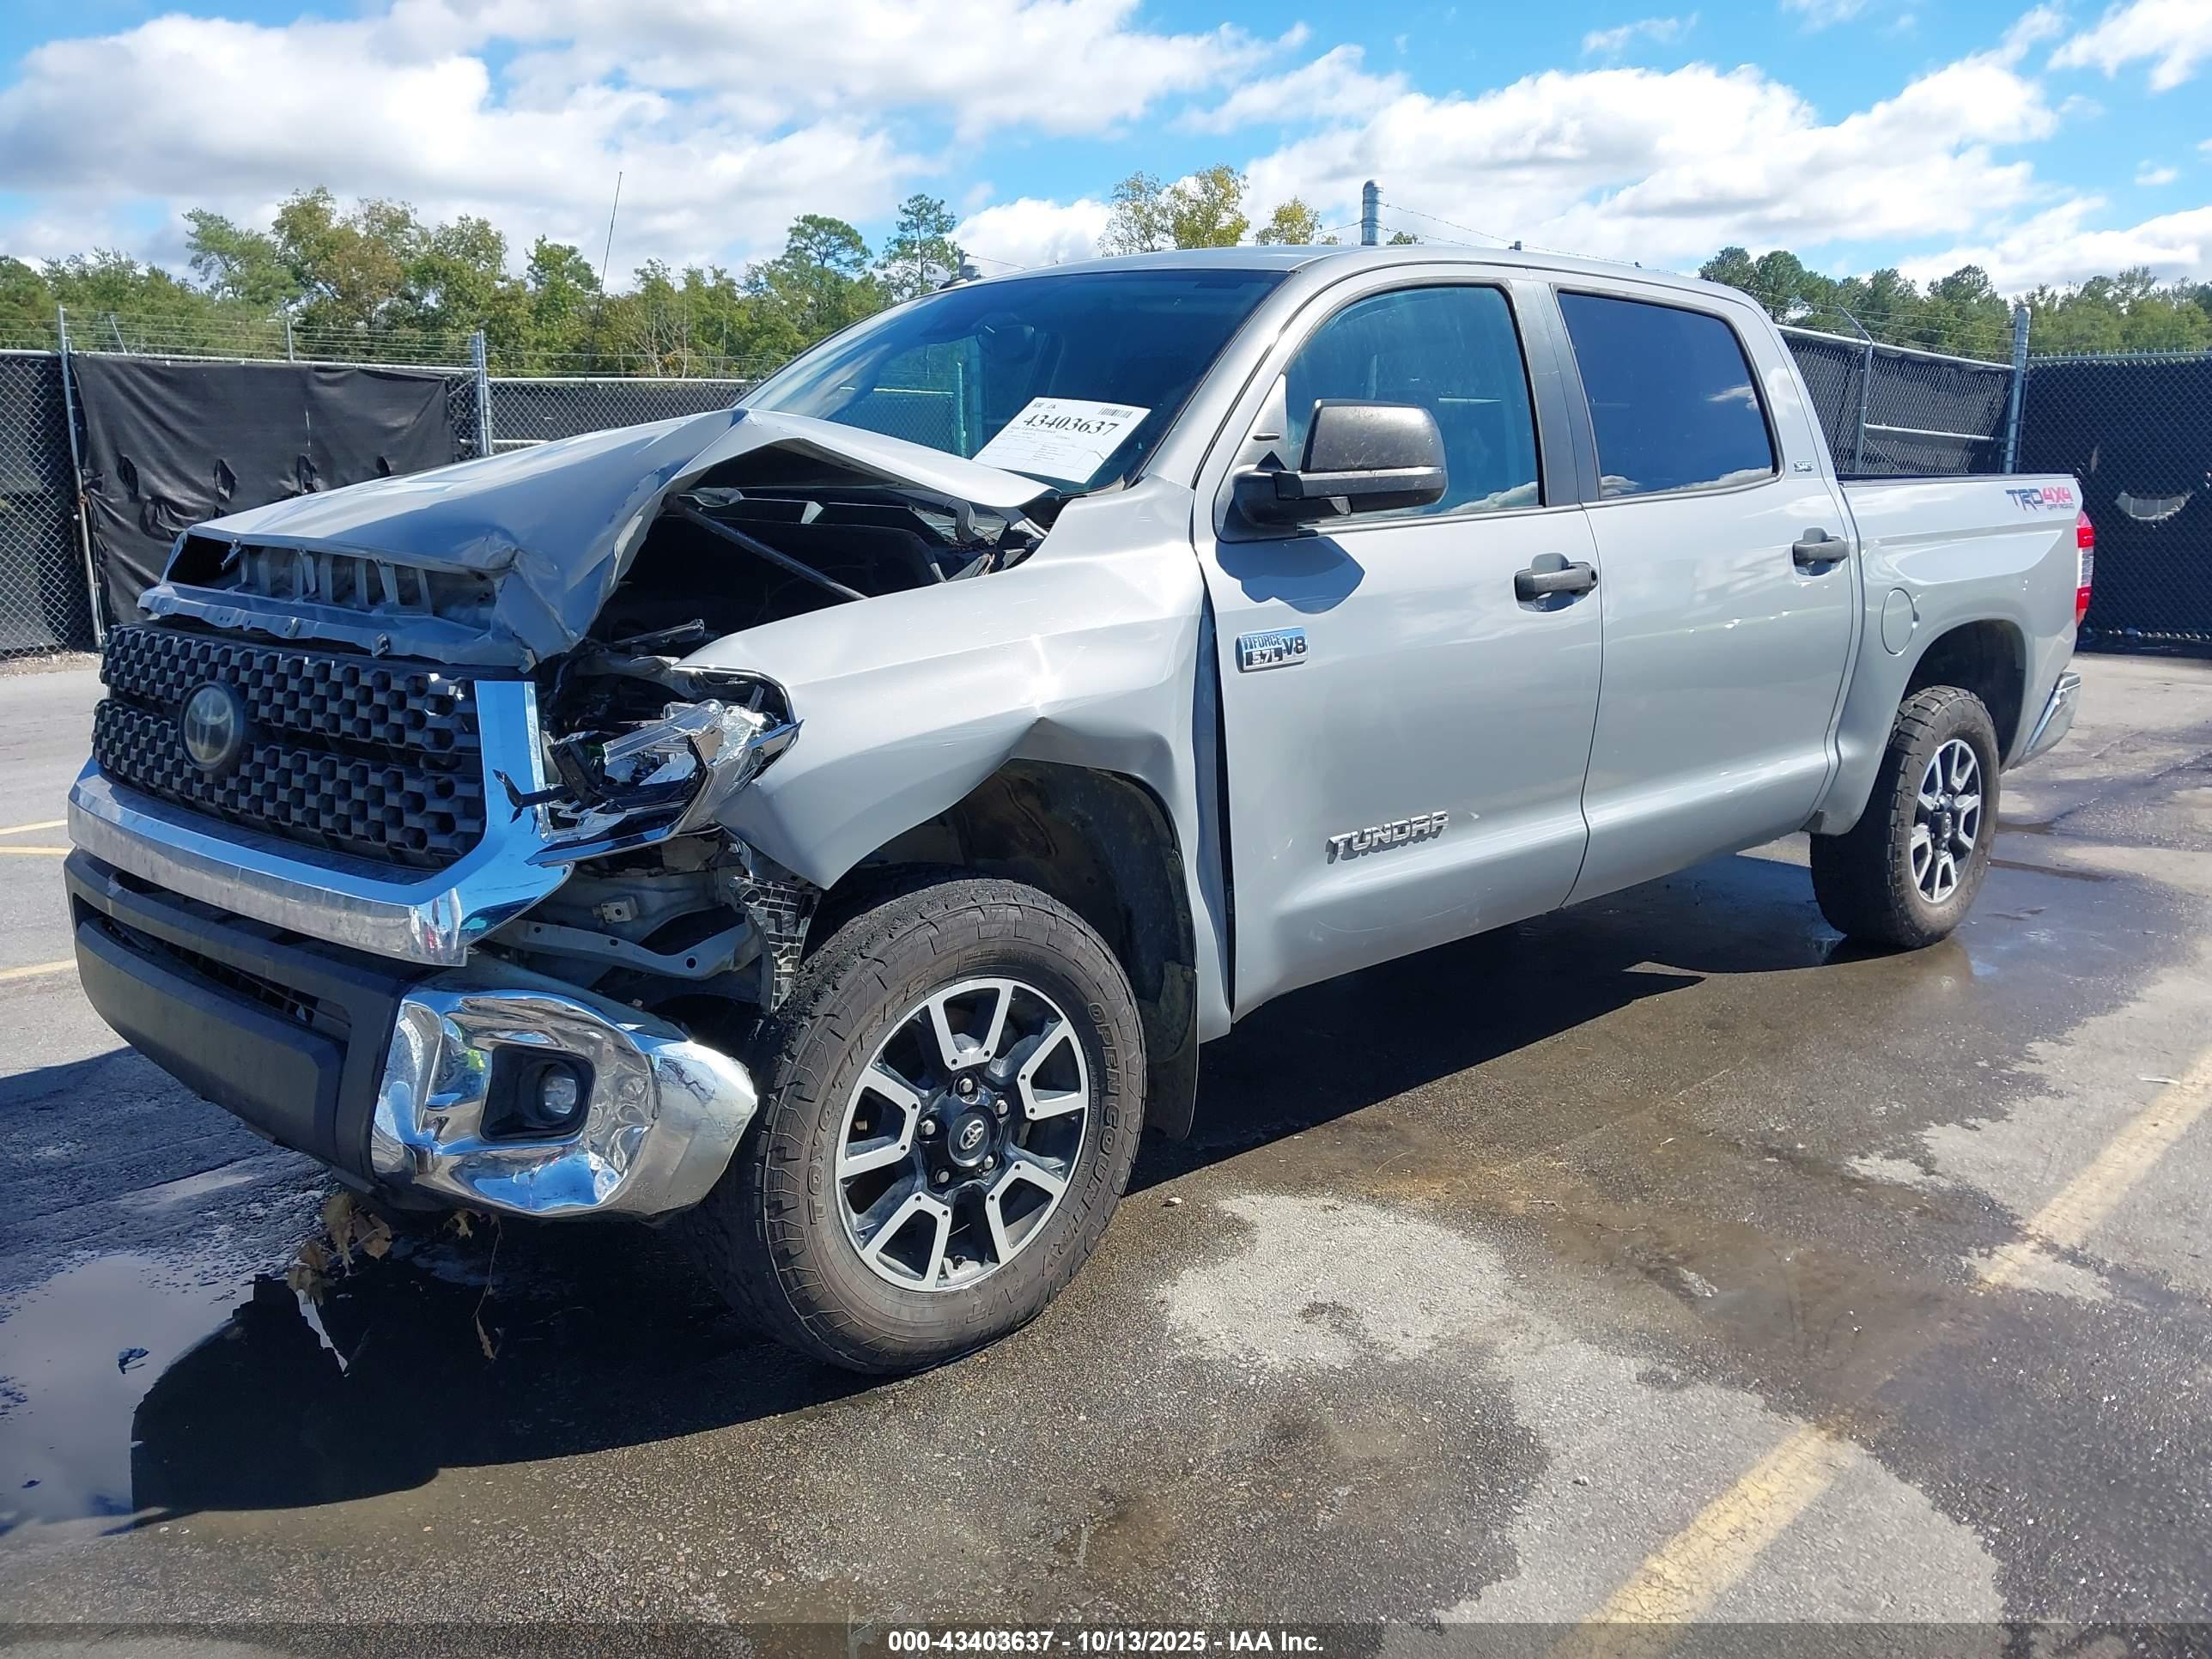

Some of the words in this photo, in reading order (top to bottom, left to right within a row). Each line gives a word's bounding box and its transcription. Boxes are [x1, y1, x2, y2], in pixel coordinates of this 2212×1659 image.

[1023, 413, 1121, 436] 43403637
[2005, 488, 2044, 511] TRD
[1250, 647, 1281, 665] 5.7L
[1281, 635, 1307, 656] V8
[1328, 810, 1449, 856] TUNDRA
[1088, 1001, 1121, 1097] OPEN
[805, 1097, 835, 1226] TOYO
